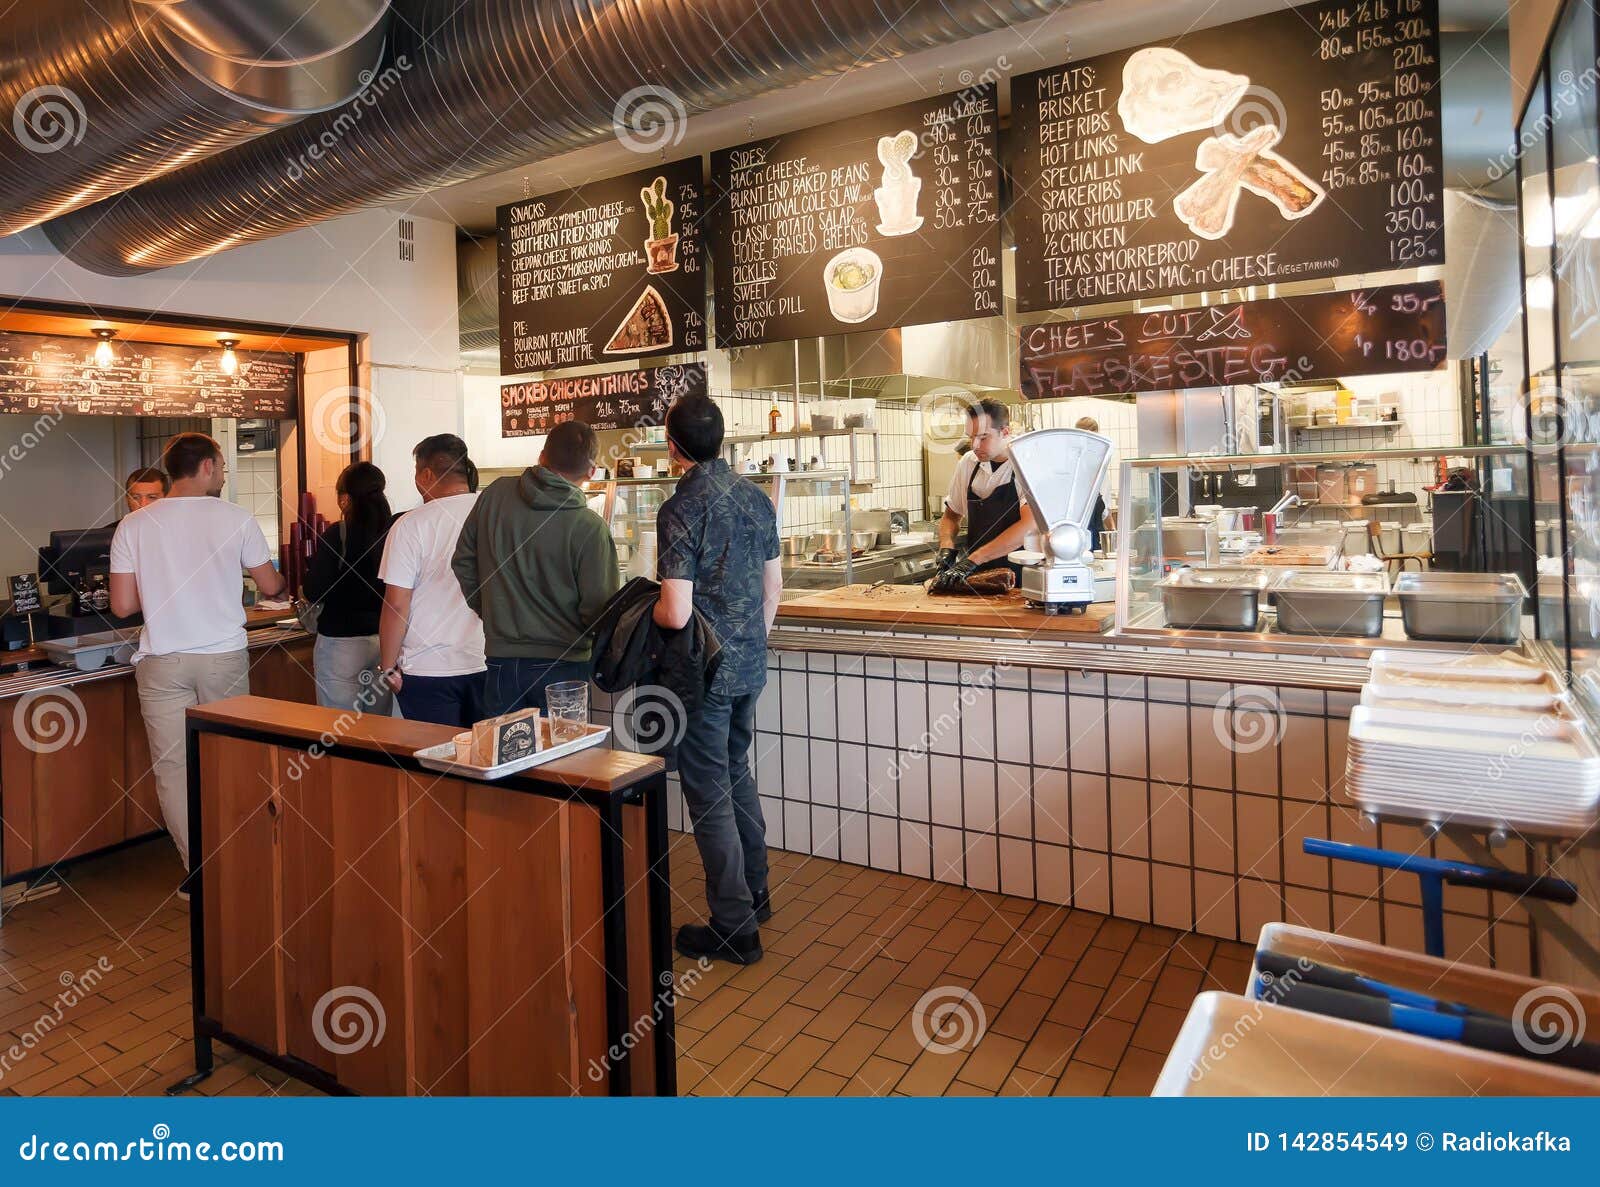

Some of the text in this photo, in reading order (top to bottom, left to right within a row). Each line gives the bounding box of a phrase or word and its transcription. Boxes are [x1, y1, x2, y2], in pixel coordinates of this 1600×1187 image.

[1039, 66, 1095, 99] MEATS:
[957, 99, 990, 119] LARGE
[1039, 88, 1106, 122] BRISKET
[1040, 111, 1110, 144] BEEF RIBS
[730, 148, 766, 171] SIDES:
[1040, 134, 1118, 166] HOT LINKS
[731, 170, 752, 190] MAC
[766, 157, 807, 182] CHEESE
[731, 162, 869, 209] BURNT END BAKED BEANS
[1041, 152, 1144, 189] SPECIAL LINK
[731, 183, 861, 227] TRADITIONAL COLE SLAW
[1041, 179, 1121, 210] SPARERIBS
[510, 223, 530, 240] HUSH
[531, 216, 558, 236] PUPPIES
[598, 201, 625, 220] CHEESE
[511, 202, 546, 223] SNACKS:
[732, 206, 854, 246] CLASSIC POTATO SALAD
[1042, 198, 1156, 234] PORK SHOULDER
[512, 217, 619, 256] SOUTHERN FRIED SHRIMP
[543, 249, 568, 265] CHEESE
[571, 244, 588, 260] PORK
[589, 238, 612, 256] RINDS
[734, 222, 868, 264] HOUSE BRAISED GREENS
[1060, 226, 1125, 253] CHICKEN
[512, 272, 532, 288] FRIED
[534, 266, 561, 284] PICKLES
[615, 250, 638, 268] CREAM
[733, 261, 778, 284] PICKLES:
[1044, 239, 1200, 279] TEXAS SMORREBROD
[512, 288, 529, 305] BEEF
[531, 283, 554, 301] JERKY
[557, 278, 583, 295] SWEET
[590, 273, 612, 290] SPICY
[733, 281, 770, 302] SWEET
[1044, 279, 1072, 302] THE
[1077, 269, 1155, 298] GENERALS
[1211, 253, 1277, 283] CHEESE
[734, 296, 805, 321] CLASSIC DILL
[514, 327, 588, 353] BOURBON PECAN PIE
[735, 319, 766, 340] SPICY
[1029, 311, 1201, 352] CHEF'S CUT
[514, 343, 594, 369] SEASONAL FRUIT PIE
[502, 383, 548, 407] SMOKED
[601, 372, 648, 395] THINGS
